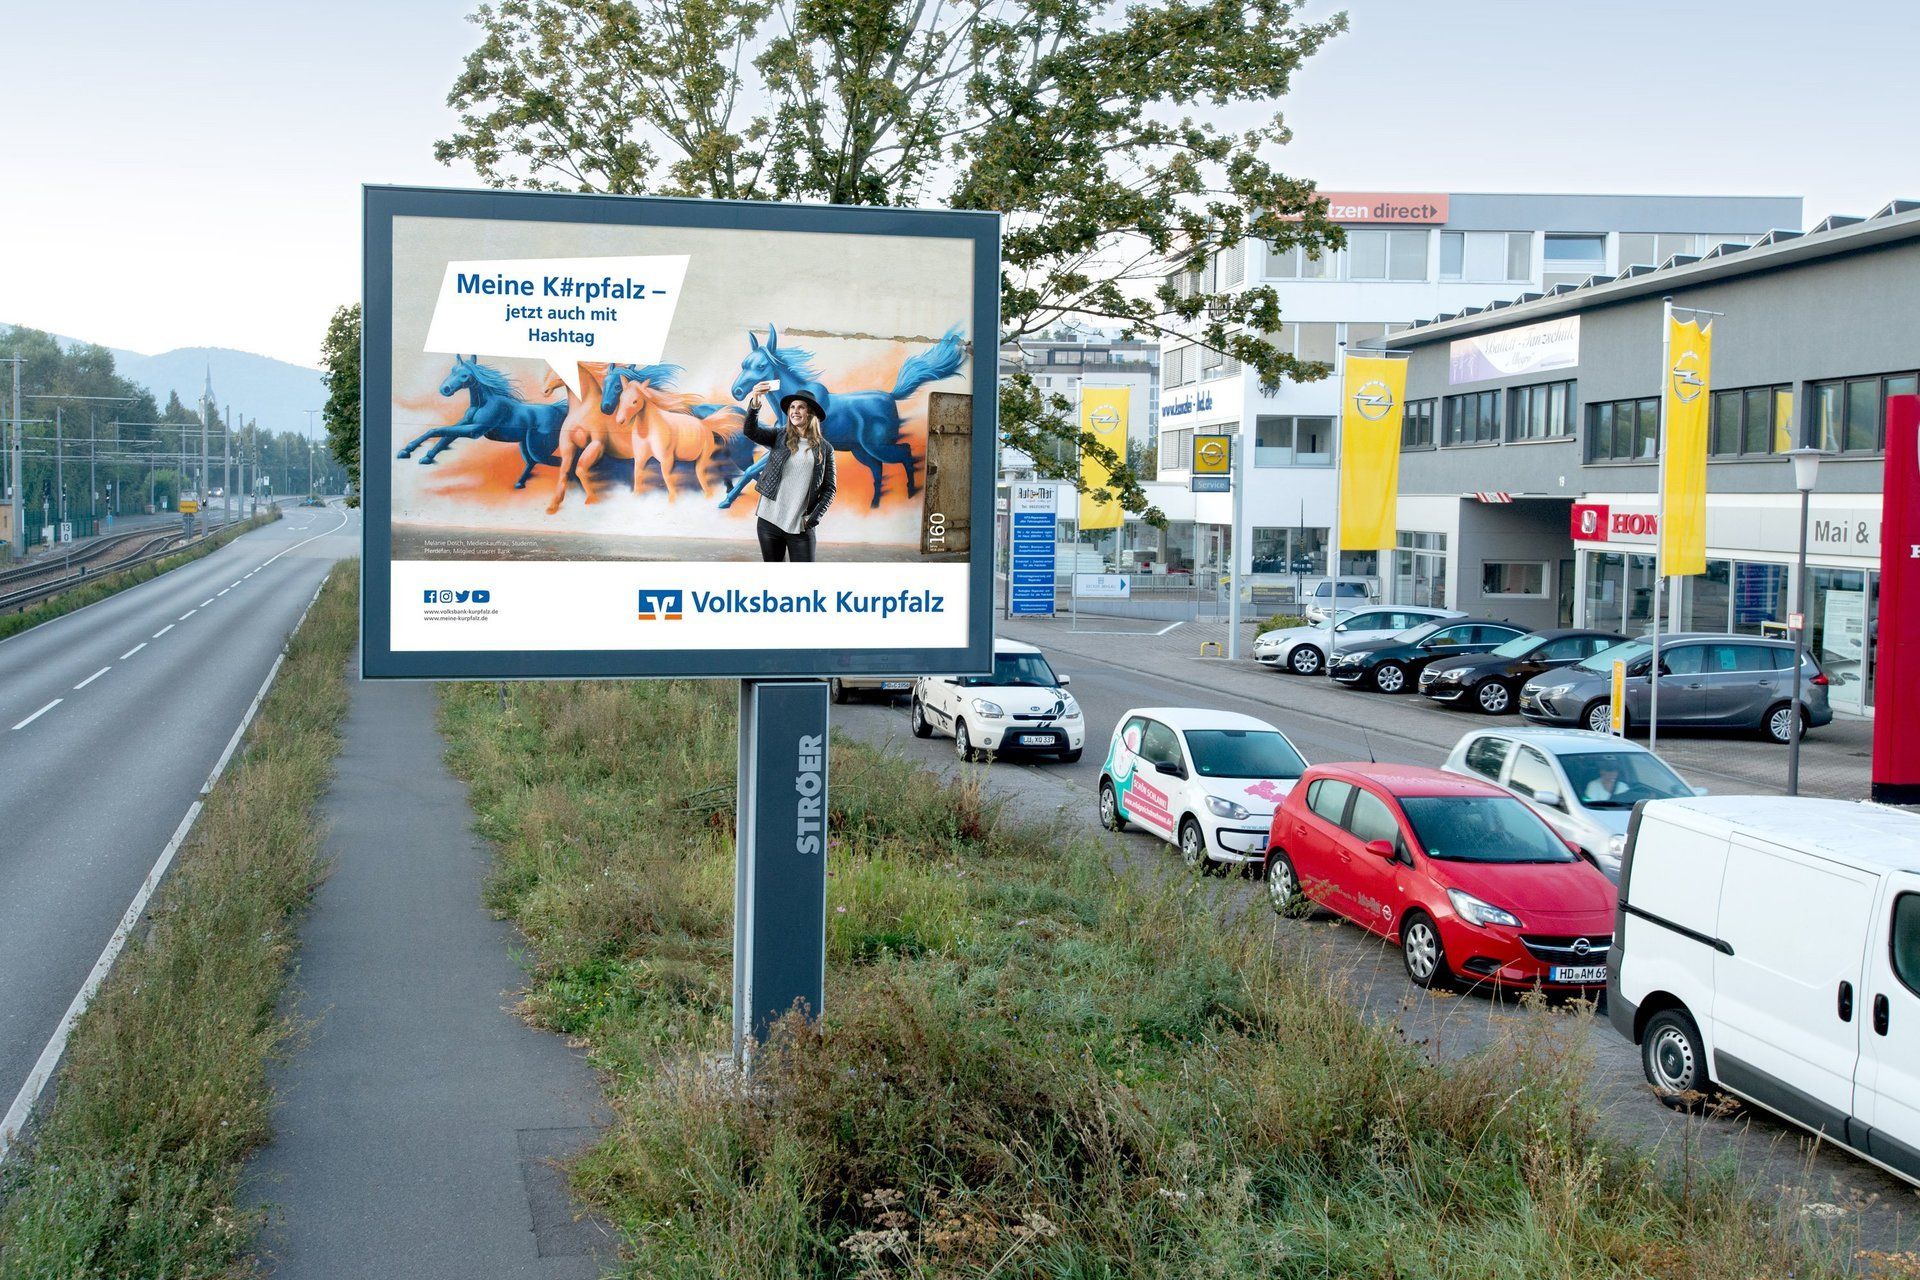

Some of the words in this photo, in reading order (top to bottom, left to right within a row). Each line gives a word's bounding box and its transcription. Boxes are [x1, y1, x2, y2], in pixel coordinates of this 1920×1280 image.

[1373, 203, 1429, 218] direct
[457, 273, 535, 296] Meine
[543, 276, 645, 303] K#rpfalz
[505, 304, 543, 321] jetzt
[547, 306, 585, 321] auch
[590, 307, 618, 322] mit
[528, 328, 595, 346] Hashtag
[1197, 481, 1225, 489] Service
[62, 524, 71, 532] 13
[929, 512, 945, 544] 160
[1611, 513, 1657, 536] HON
[1814, 520, 1848, 543] Mai
[1855, 521, 1869, 544] &
[63, 534, 69, 542] 0
[423, 608, 499, 616] www.volksbank-kurpfalz.de
[691, 589, 827, 614] Volksbank
[836, 590, 944, 619] Kurpfalz
[795, 734, 822, 855] STRÖER
[1133, 779, 1147, 795] SCHÖN
[1560, 968, 1574, 979] HD
[1580, 968, 1594, 979] AM
